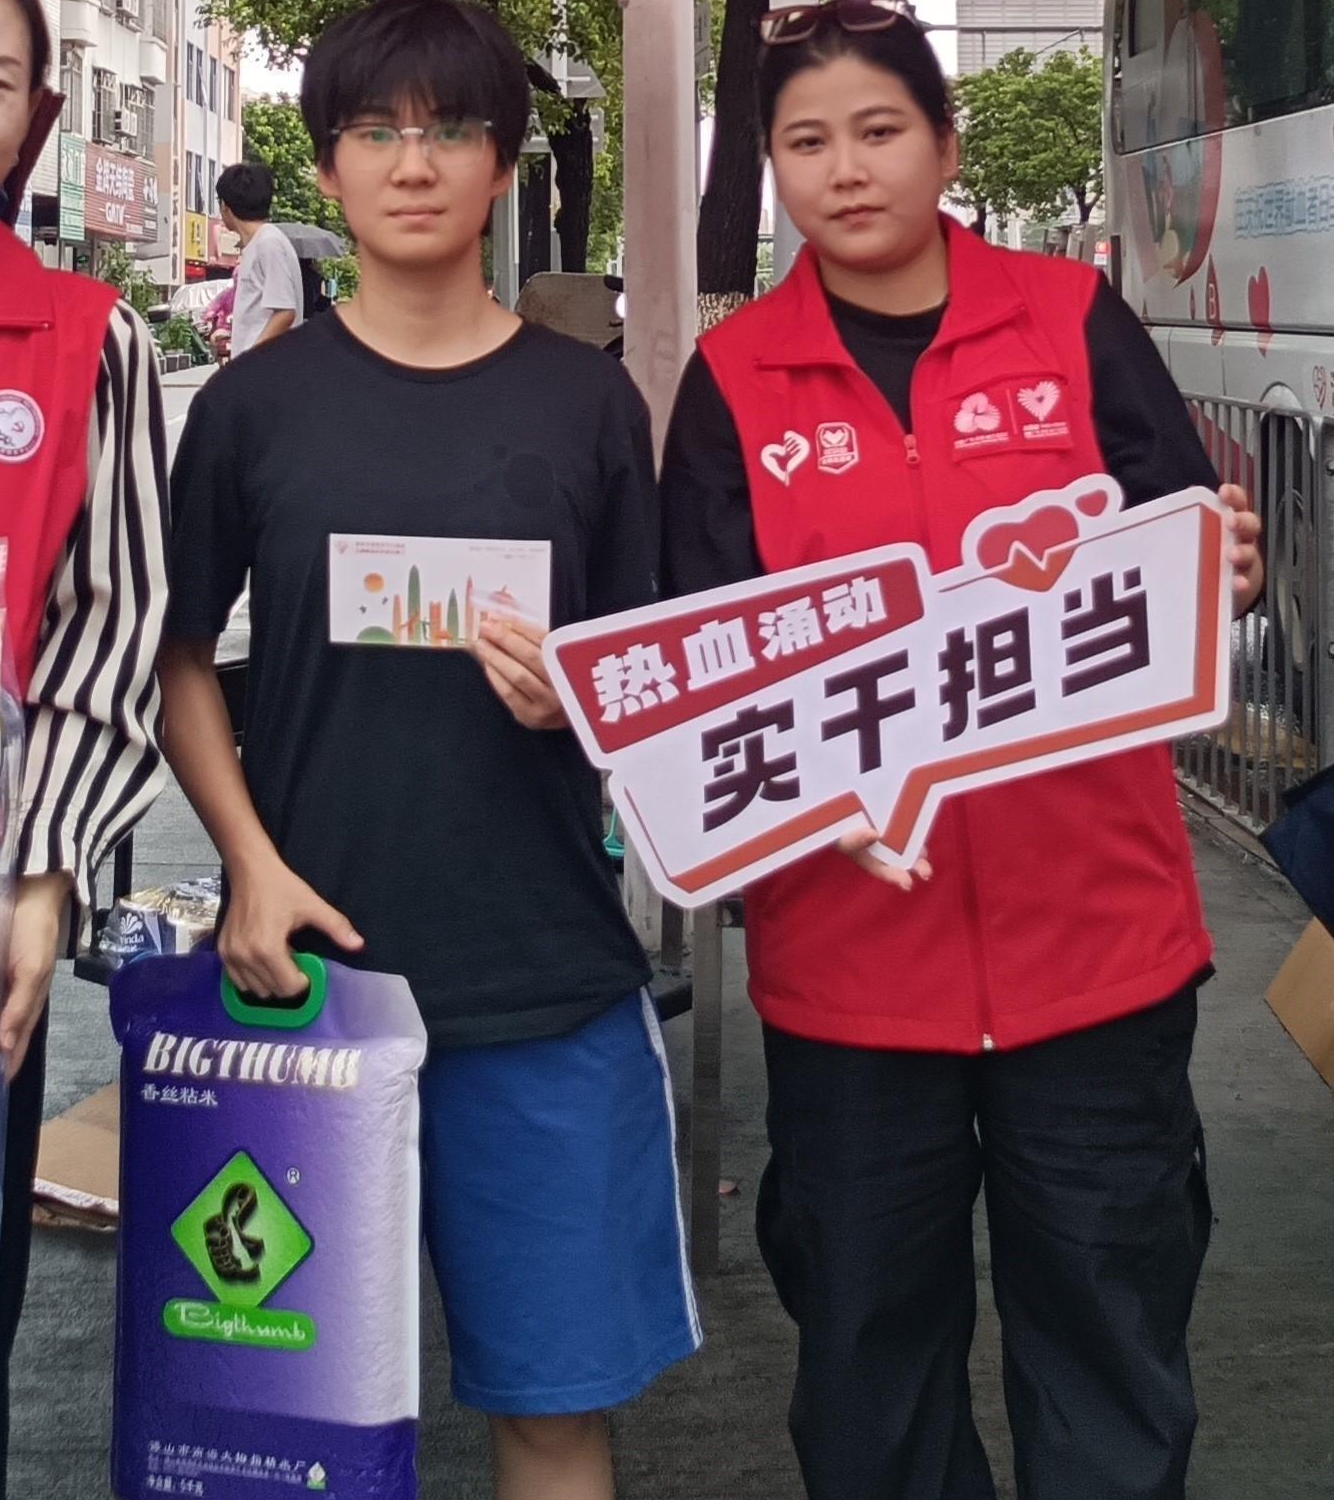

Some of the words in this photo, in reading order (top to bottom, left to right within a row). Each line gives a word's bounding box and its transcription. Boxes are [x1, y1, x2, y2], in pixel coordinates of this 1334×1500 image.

[592, 574, 885, 724] 热血涌动
[701, 565, 1151, 833] 实干担当
[143, 1031, 361, 1090] BIGTHUMB
[173, 1303, 307, 1342] Bigthumb
